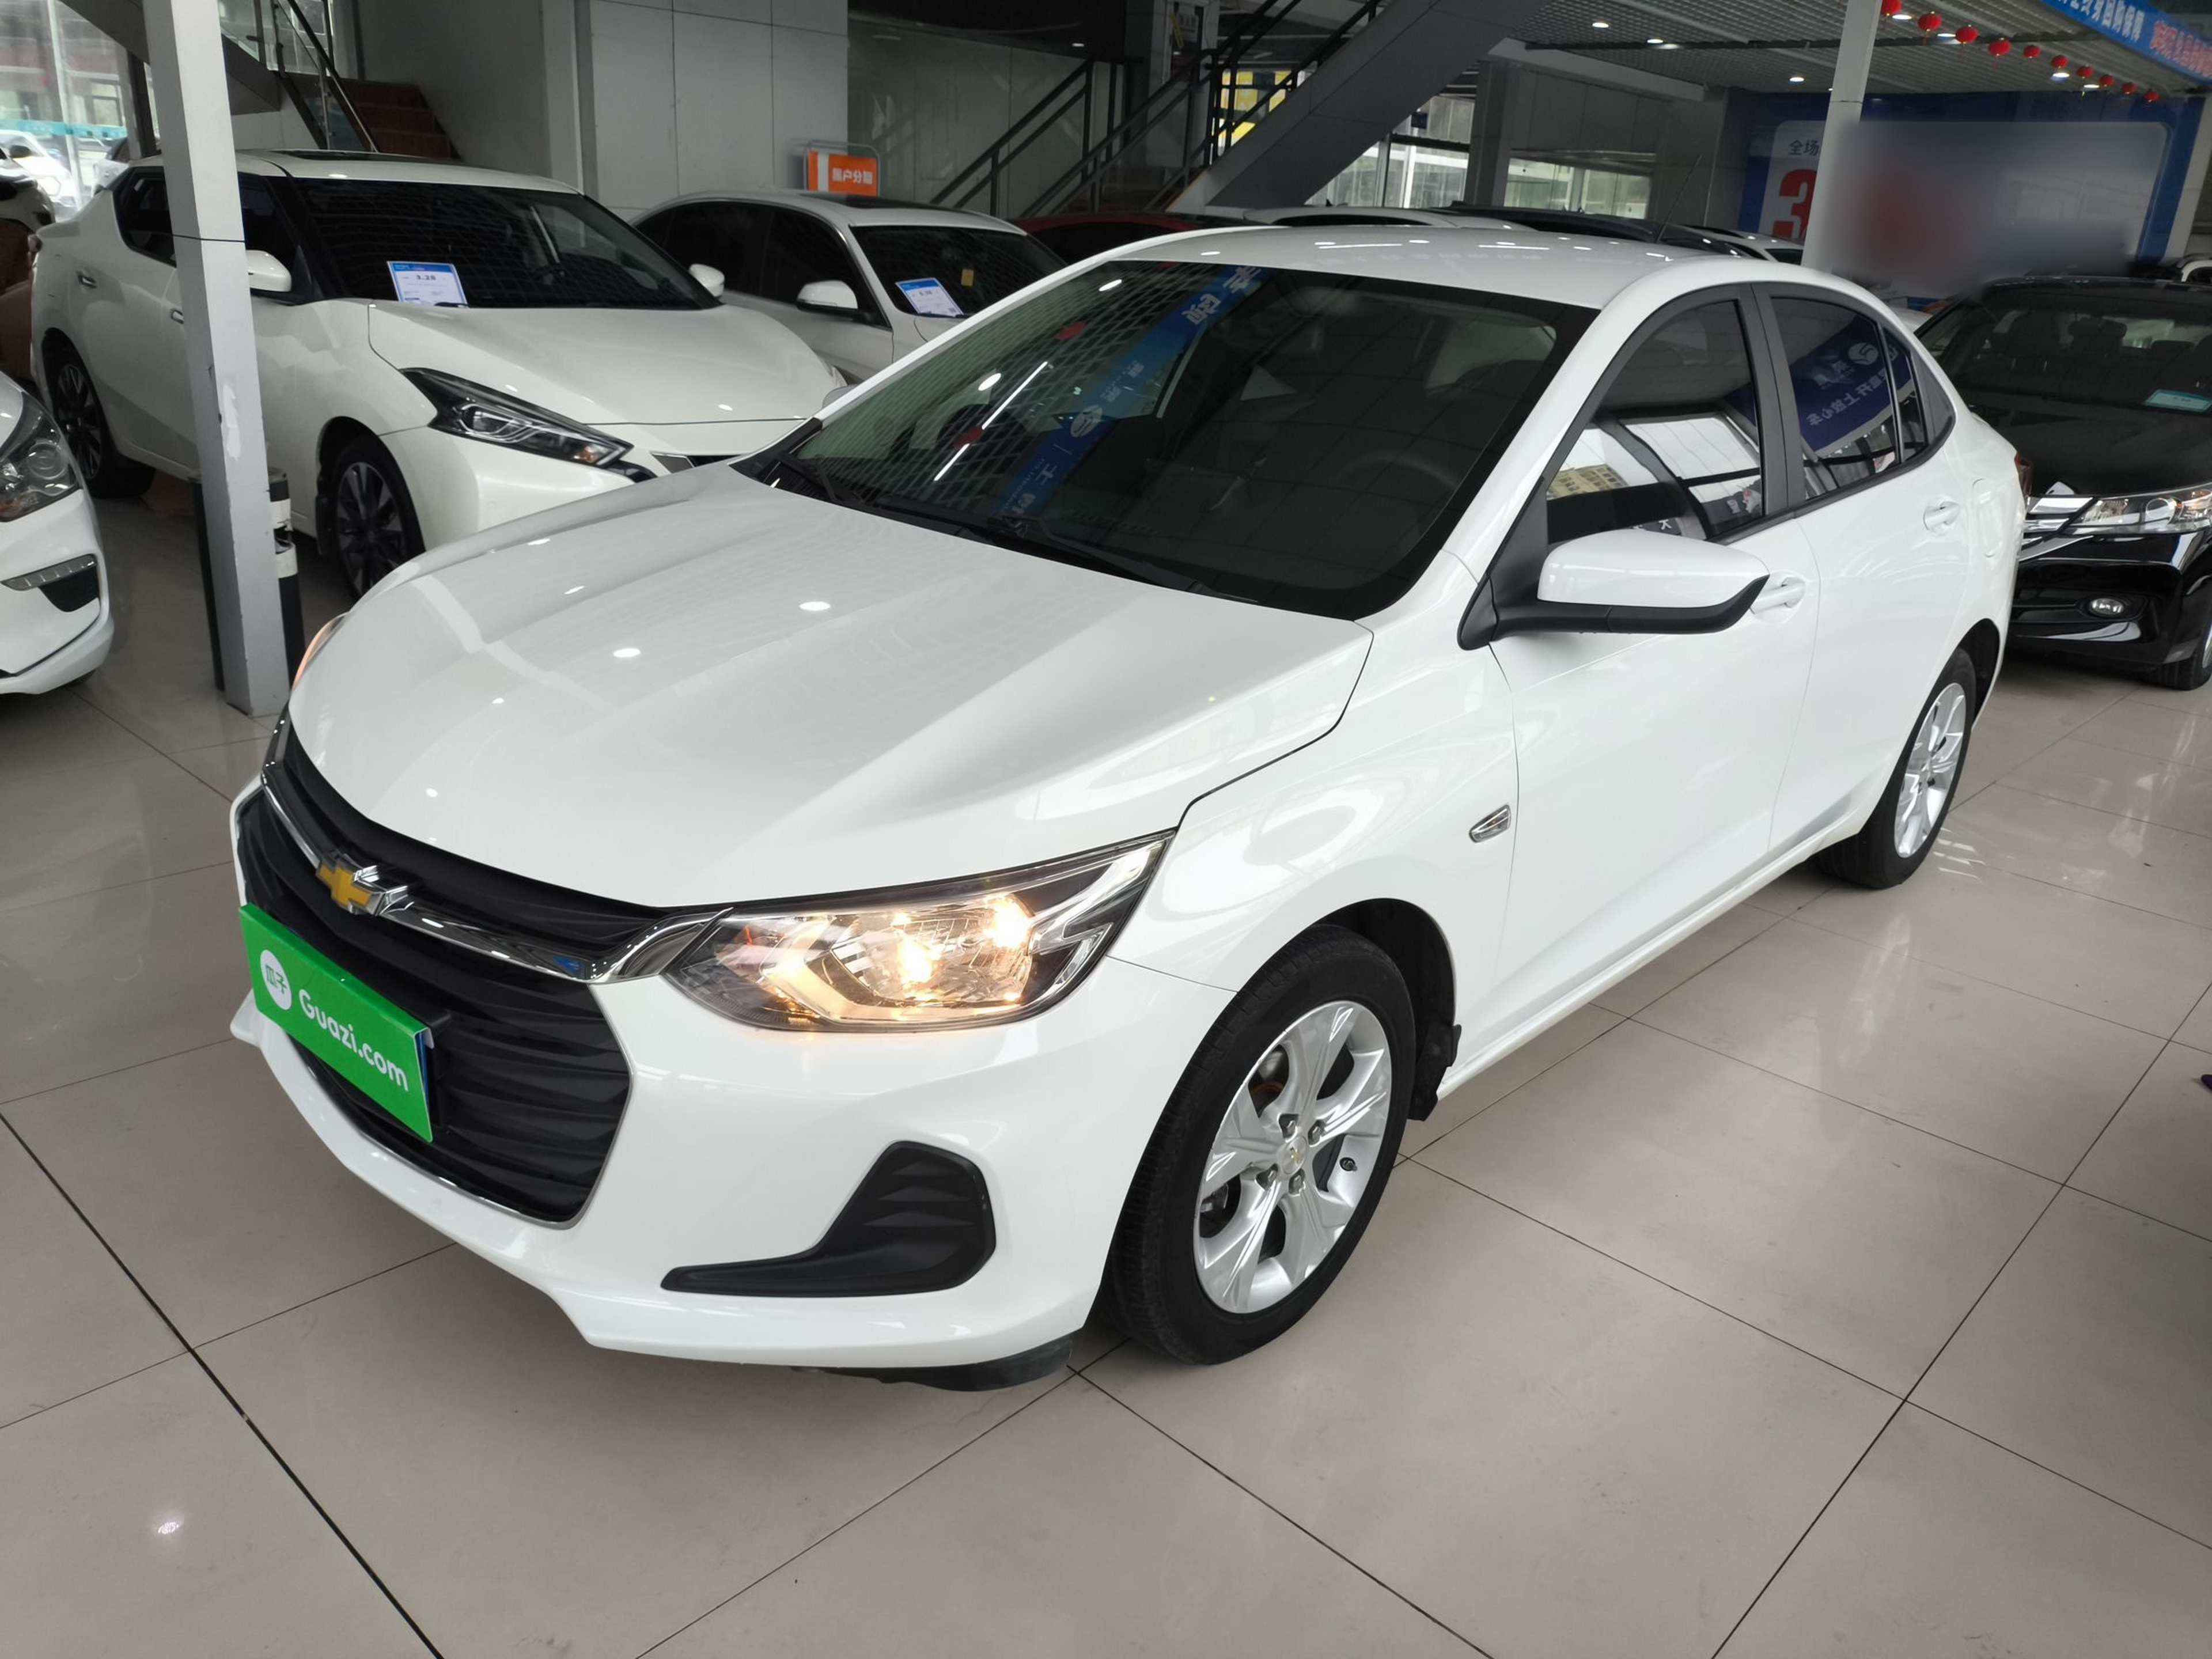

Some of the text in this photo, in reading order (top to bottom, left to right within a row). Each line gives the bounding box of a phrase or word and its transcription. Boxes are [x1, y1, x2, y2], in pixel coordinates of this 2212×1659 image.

[1789, 139, 1820, 156] 全场
[265, 964, 286, 994] 瓜子
[299, 988, 408, 1092] Guazi.com
